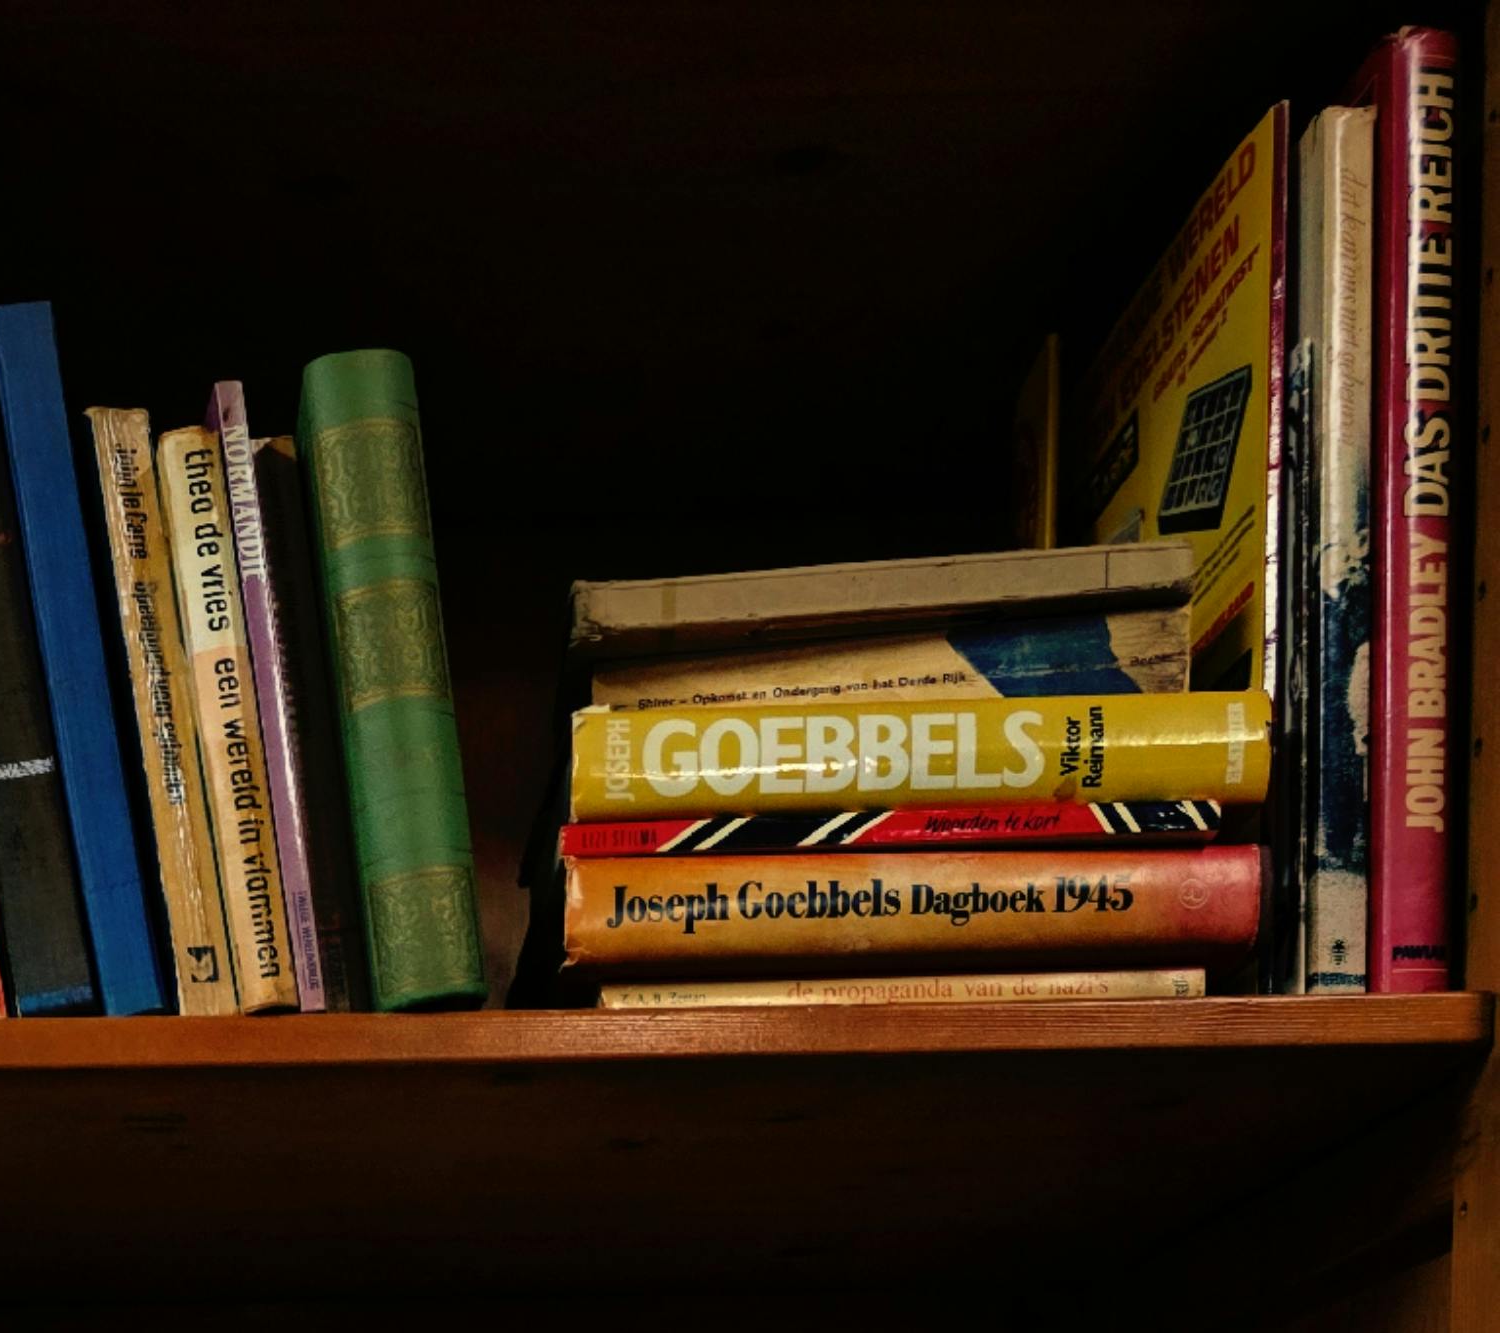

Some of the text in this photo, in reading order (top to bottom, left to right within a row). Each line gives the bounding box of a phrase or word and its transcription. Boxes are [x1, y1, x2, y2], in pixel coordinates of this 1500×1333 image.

[1403, 74, 1455, 833] JOHN BRADLEY DAS DRITTE REICH
[184, 448, 281, 977] theo de vries een wereld in vlammen
[642, 708, 1046, 797] GOEBBELS
[606, 872, 1135, 934] Joseph Goebbels Dagboek 1945
